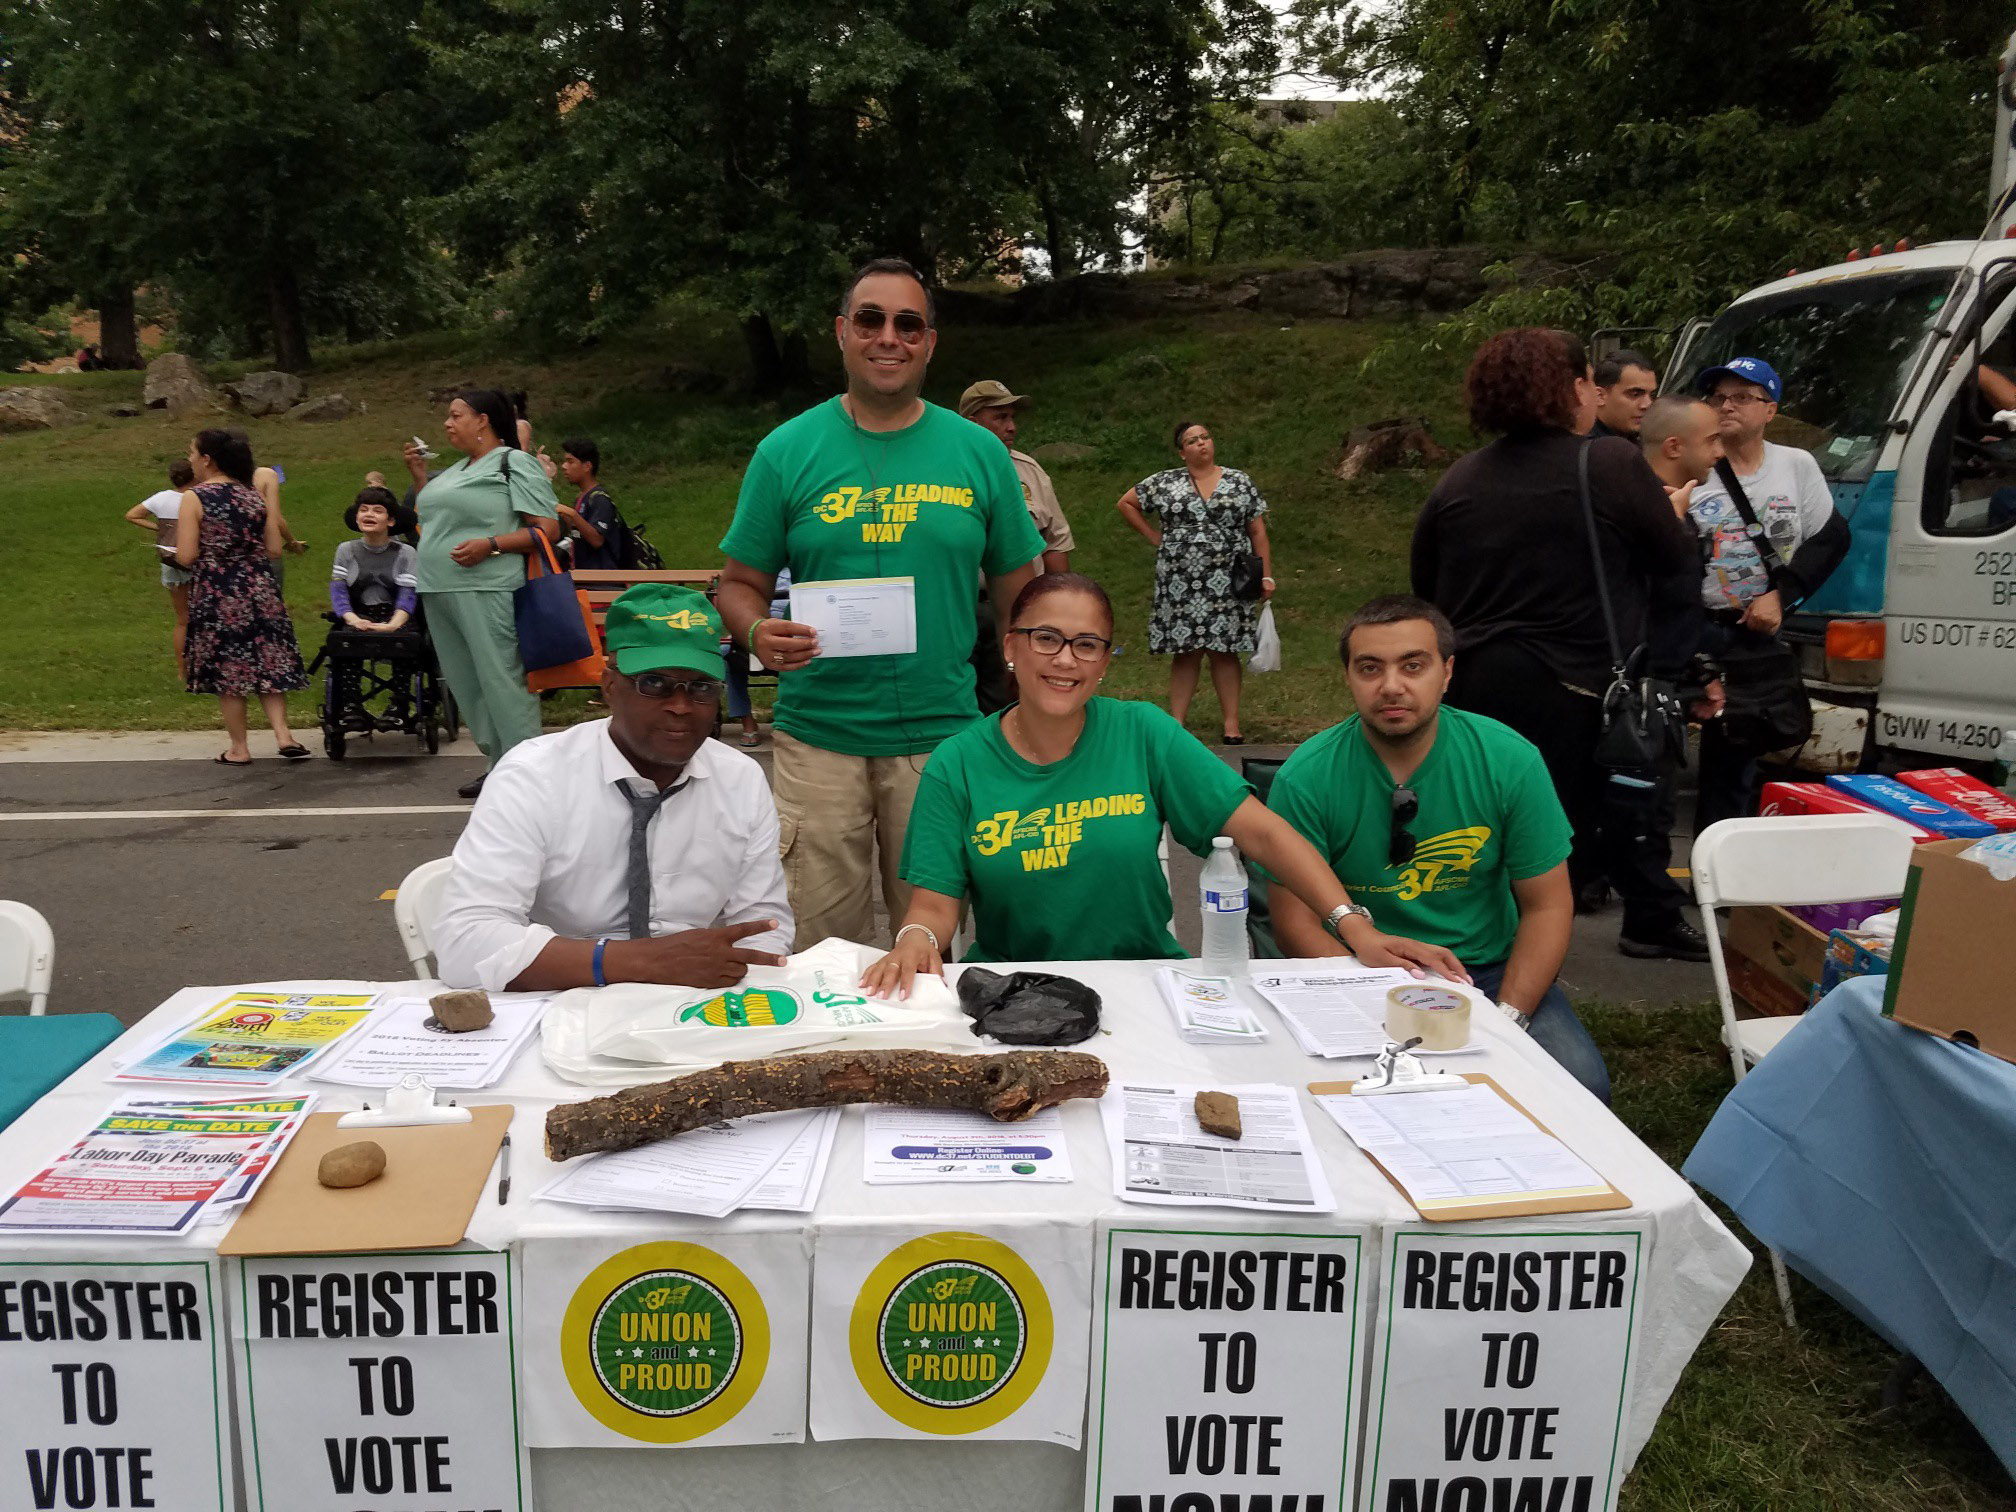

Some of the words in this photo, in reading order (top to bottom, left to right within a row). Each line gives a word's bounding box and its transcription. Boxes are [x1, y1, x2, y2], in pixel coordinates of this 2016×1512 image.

[820, 486, 862, 524] 37
[894, 484, 975, 508] LEADING
[882, 502, 919, 523] THE
[862, 523, 907, 543] WAY
[1974, 551, 2016, 576] 252
[1901, 622, 1928, 645] US
[1932, 624, 1976, 647] DOT
[1978, 625, 1990, 647] #
[1884, 715, 1931, 740] GVW
[1937, 721, 2002, 750] 14,250
[1054, 793, 1146, 825] LEADING
[975, 809, 1020, 856] 37
[1041, 821, 1084, 847] THE
[1020, 844, 1072, 872] WAY
[1397, 862, 1444, 901] 37
[108, 1119, 174, 1131] SAVE
[173, 1123, 205, 1131] THE
[208, 1121, 274, 1133] DATE
[69, 1147, 131, 1161] Labor
[129, 1149, 169, 1165] Day
[169, 1151, 243, 1164] Parade
[938, 1147, 974, 1155] Register
[1119, 1248, 1346, 1313] REGISTER
[1403, 1250, 1627, 1312] REGISTER
[258, 1271, 499, 1338] REGISTER
[908, 1302, 997, 1332] UNION
[620, 1312, 711, 1341] UNION
[651, 1343, 680, 1360] and
[938, 1334, 966, 1351] and
[906, 1353, 997, 1381] PROUD
[1198, 1331, 1257, 1394] TO
[1481, 1331, 1540, 1389] TO
[349, 1356, 415, 1416] TO
[619, 1363, 712, 1390] PROUD
[52, 1362, 118, 1426] TO
[1166, 1414, 1283, 1475] VOTE
[1444, 1406, 1560, 1462] VOTE
[25, 1446, 156, 1510] VOTE
[324, 1436, 452, 1494] VOTE
